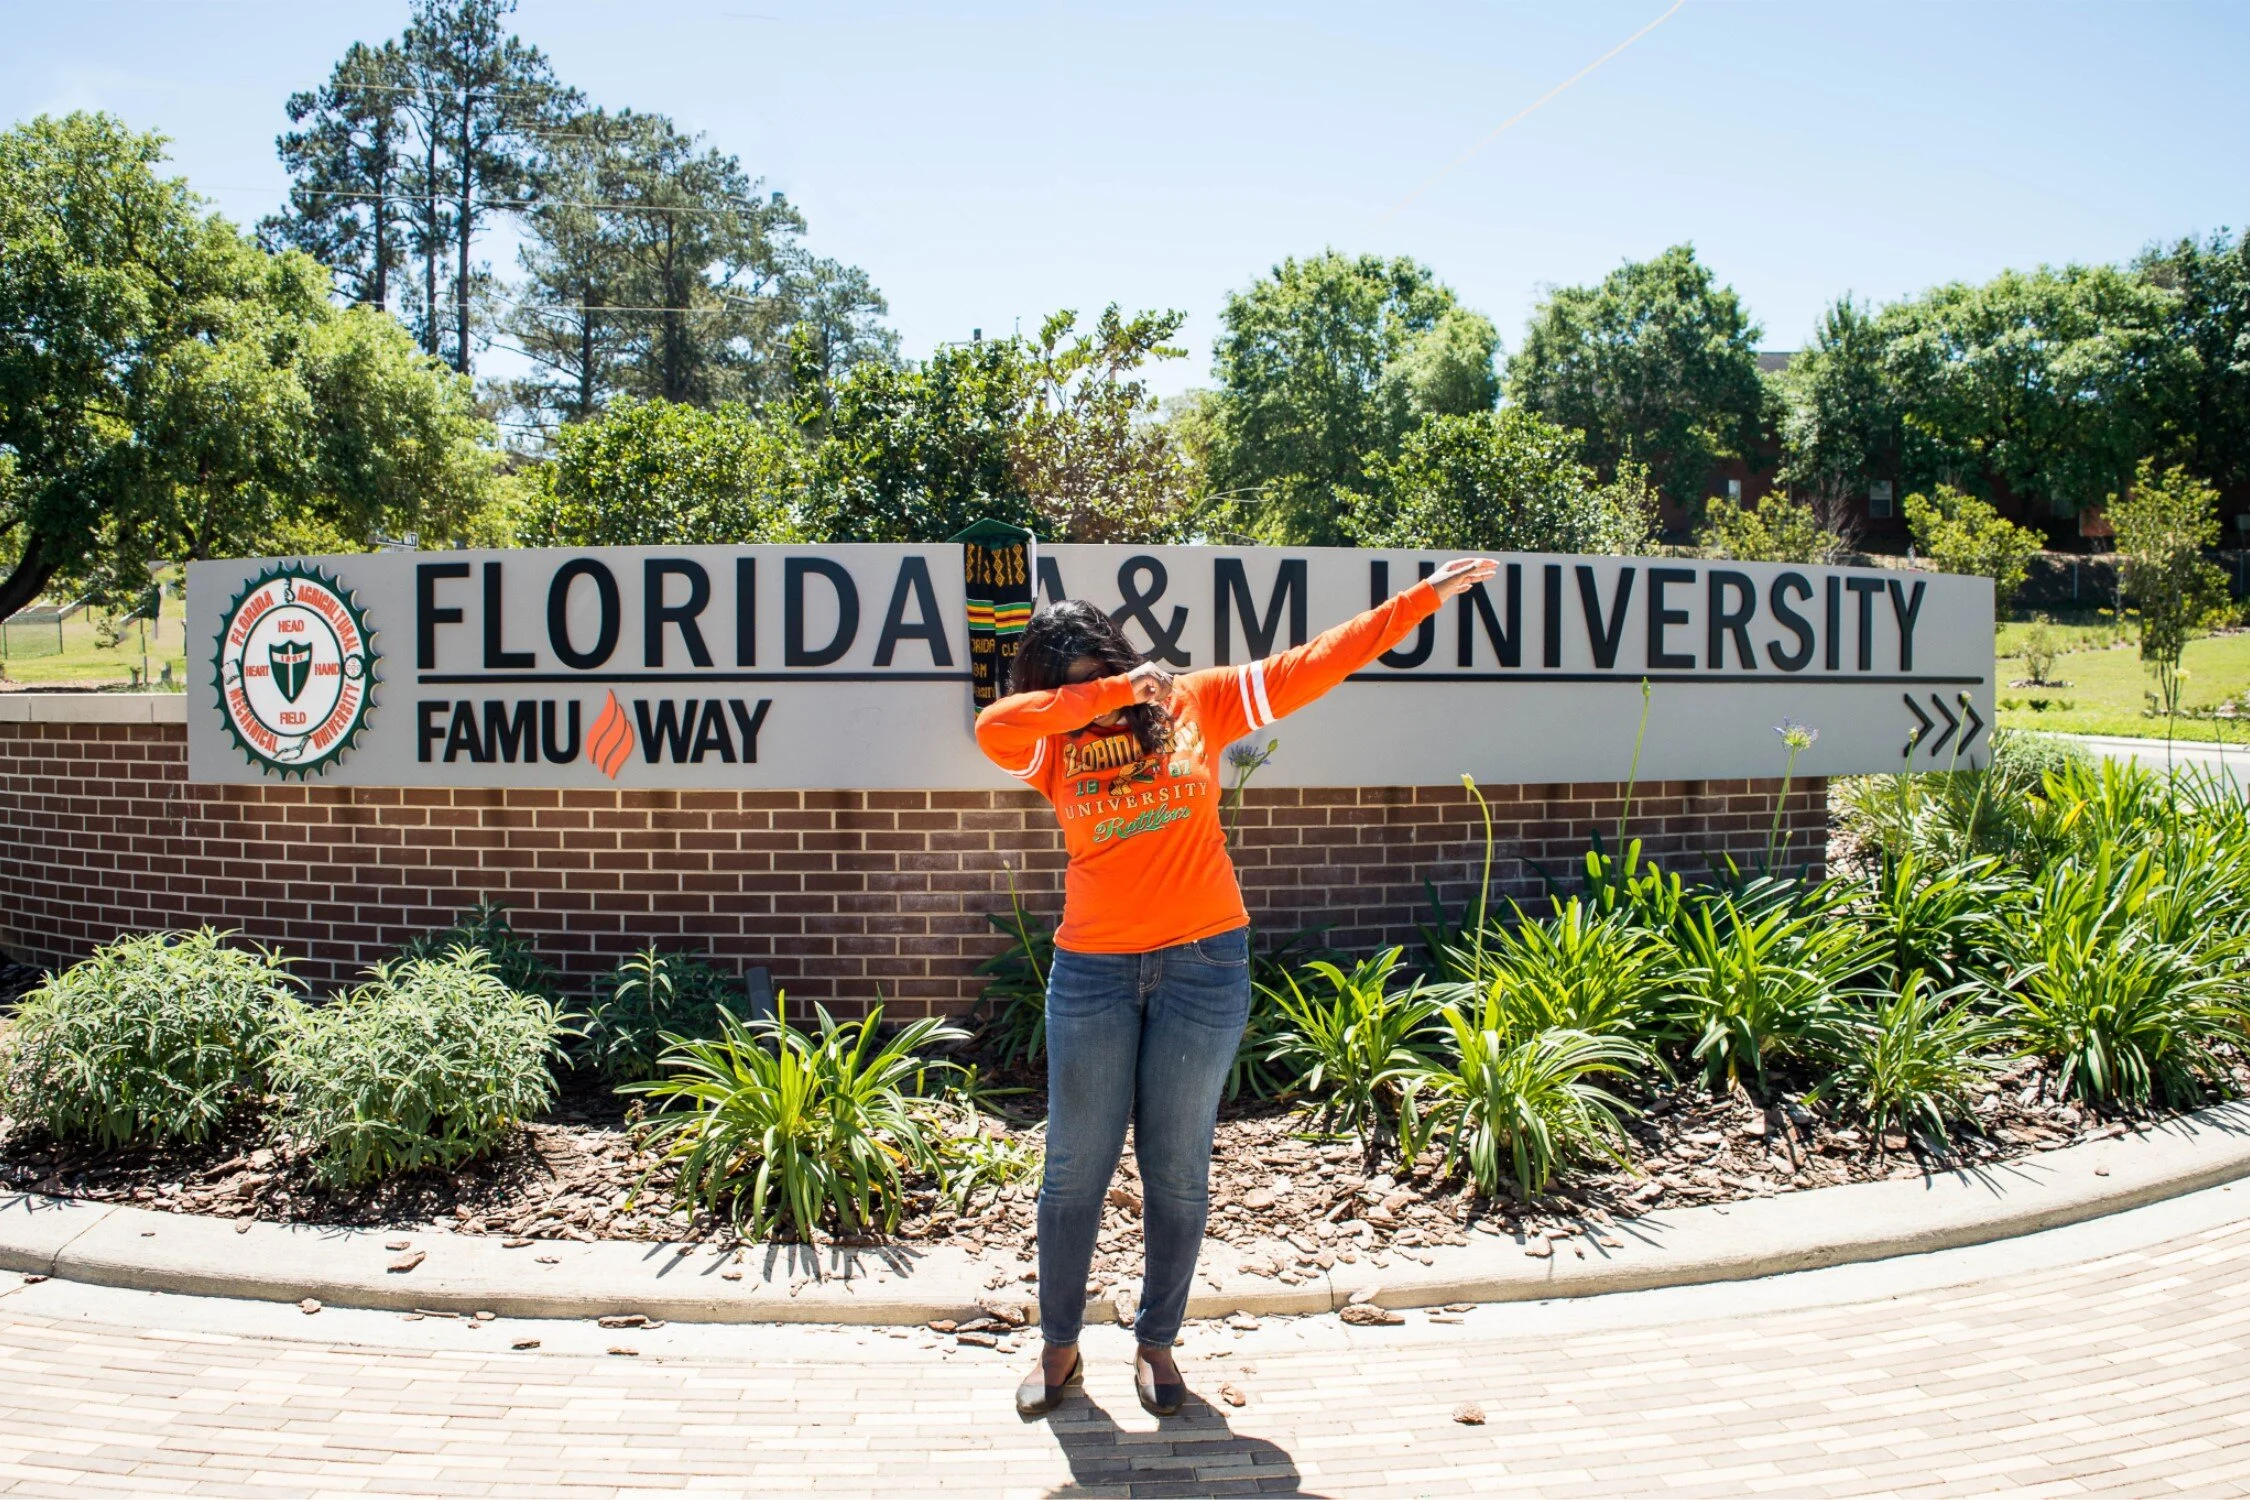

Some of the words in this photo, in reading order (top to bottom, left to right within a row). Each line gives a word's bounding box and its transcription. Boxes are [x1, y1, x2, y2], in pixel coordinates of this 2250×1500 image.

[231, 590, 274, 648] FLORIDA
[278, 619, 304, 633] HEAD
[297, 585, 359, 653] AGRICULTURAL
[417, 556, 954, 670] FLORIDA
[1369, 561, 1927, 672] UNIVERSITY
[246, 665, 269, 677] HEART
[314, 663, 340, 676] HAND
[228, 687, 278, 754] MECHANICAL
[280, 711, 306, 725] FIELD
[310, 683, 360, 750] UNIVERSITY
[417, 699, 580, 764] FAMU
[633, 699, 773, 764] WAY
[1064, 782, 1208, 820] UNIVERSITY
[1093, 803, 1192, 843] Rattlers
